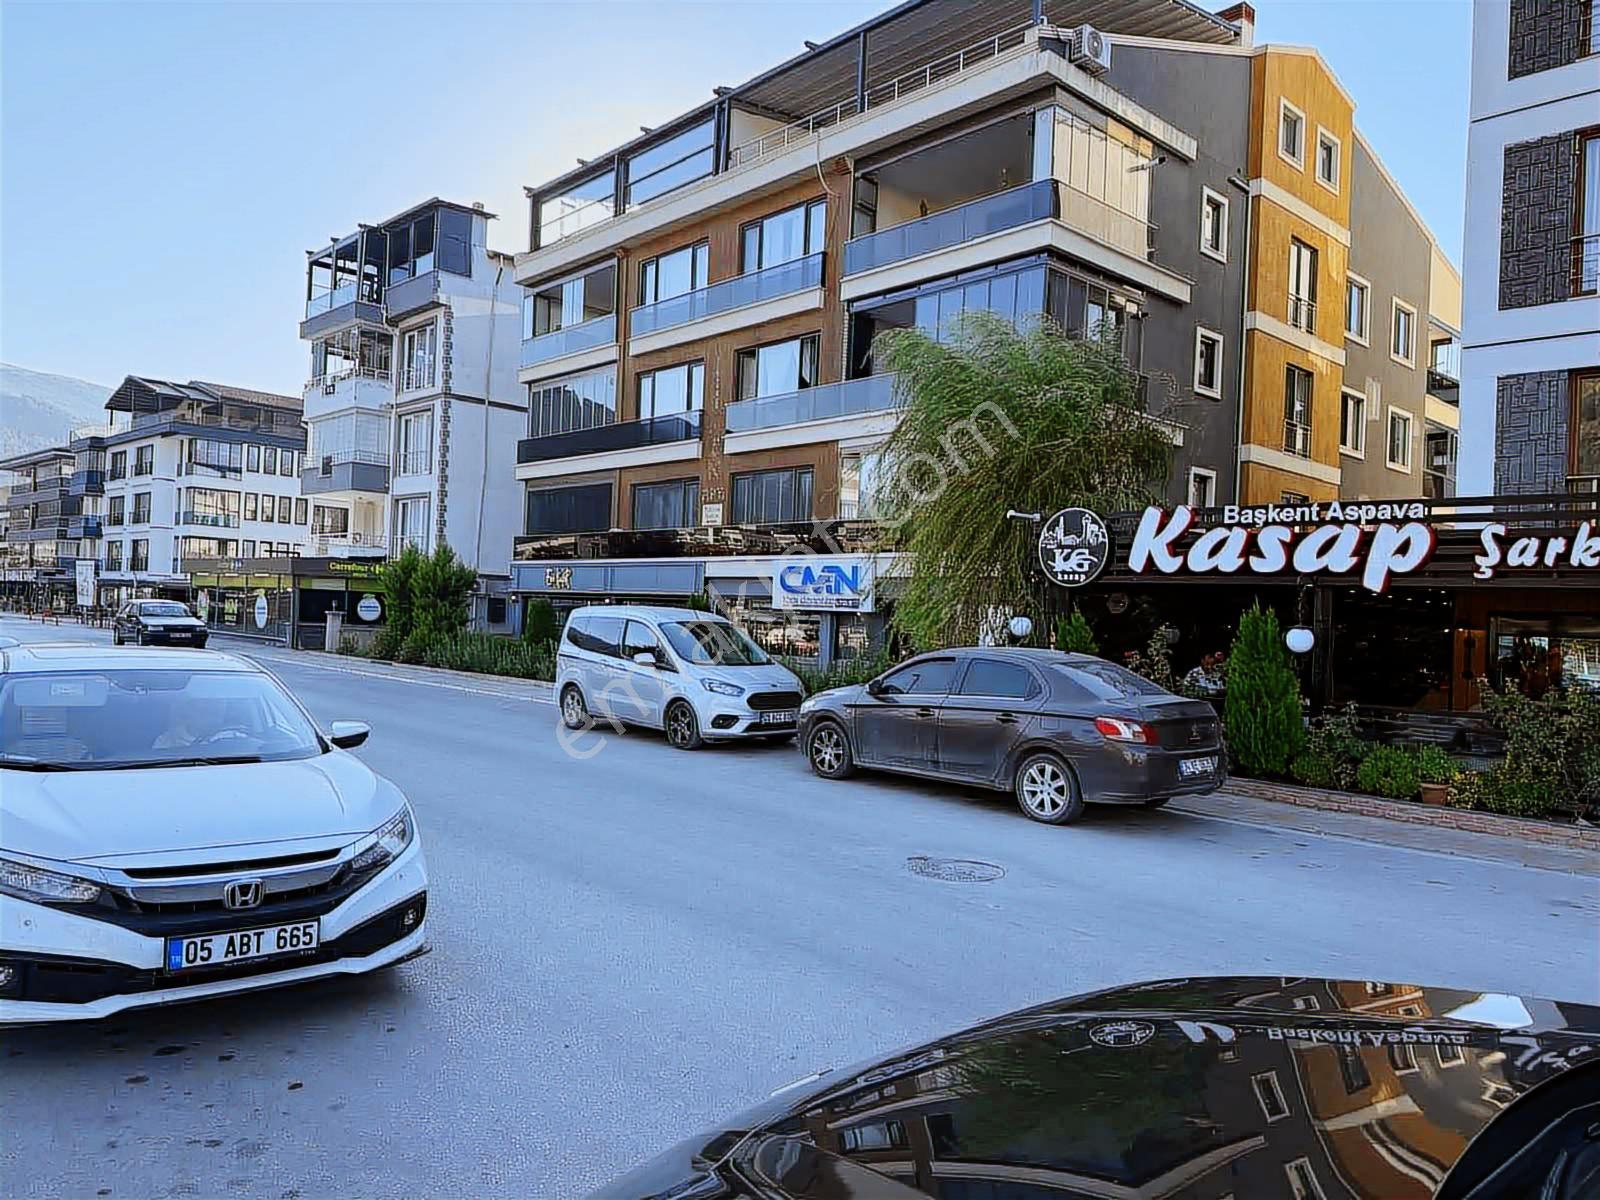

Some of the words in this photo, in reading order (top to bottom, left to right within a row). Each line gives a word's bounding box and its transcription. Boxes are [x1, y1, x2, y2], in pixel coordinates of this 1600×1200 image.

[1223, 503, 1320, 527] Başkent
[1325, 501, 1425, 524] Aspava
[1128, 504, 1433, 592] Kasap
[1473, 521, 1600, 578] Şark
[185, 938, 213, 964] 05
[224, 931, 265, 958] ABT
[276, 924, 314, 949] 665
